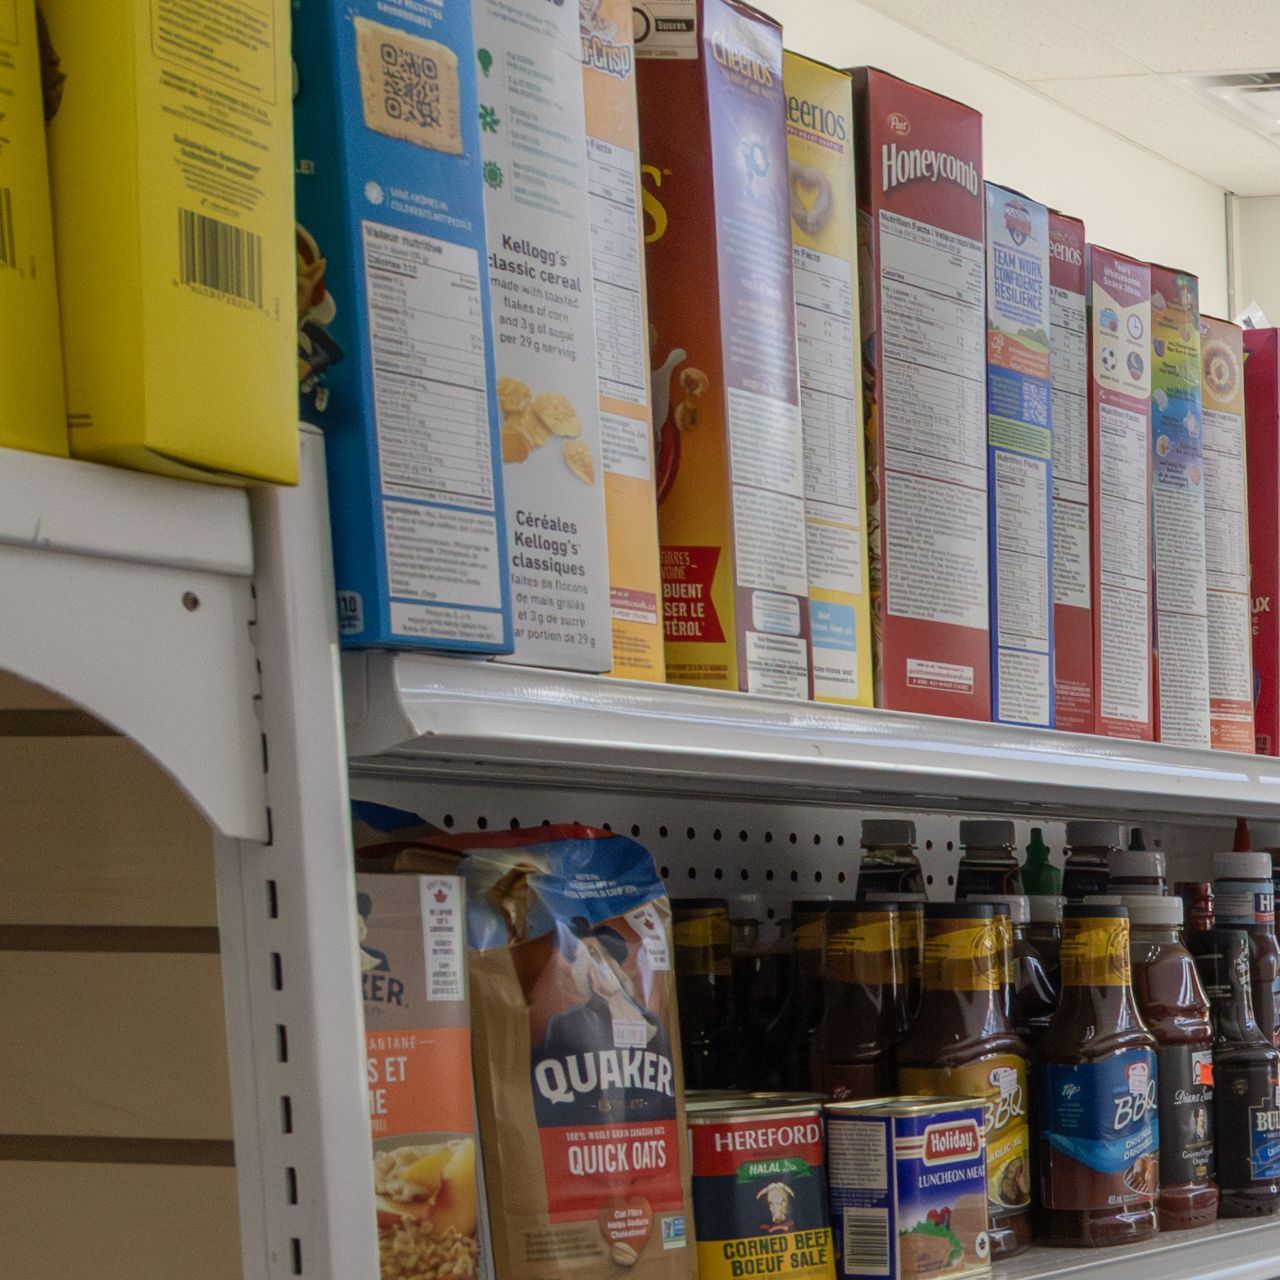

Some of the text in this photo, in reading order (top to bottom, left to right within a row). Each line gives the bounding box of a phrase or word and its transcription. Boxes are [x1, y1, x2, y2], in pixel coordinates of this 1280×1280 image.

[711, 31, 773, 88] Cheerios
[881, 144, 978, 196] Honeycomb
[502, 234, 568, 267] Kellogg's
[994, 248, 1041, 275] TEAM WORK
[490, 276, 519, 292] made
[540, 262, 581, 292] cereal
[994, 265, 1042, 294] CONFIDENCE
[504, 295, 536, 314] flakes
[994, 280, 1042, 312] RESILIENCE
[516, 510, 577, 534] Céréales
[514, 531, 579, 556] Kellogg's
[512, 554, 585, 578] classiques
[690, 604, 705, 617] LE
[385, 1056, 408, 1083] ET
[535, 1048, 674, 1104] QUAKER
[1113, 1081, 1157, 1131] BBQ
[714, 1122, 820, 1153] HEREFORD
[931, 1126, 979, 1154] Holiday
[568, 1139, 667, 1177] QUICK OATS
[749, 1161, 783, 1176] HALAL
[918, 1170, 966, 1190] LUNCHEON
[723, 1228, 831, 1261] CORNED BEEF
[731, 1244, 829, 1278] BOEUF SALÉ
